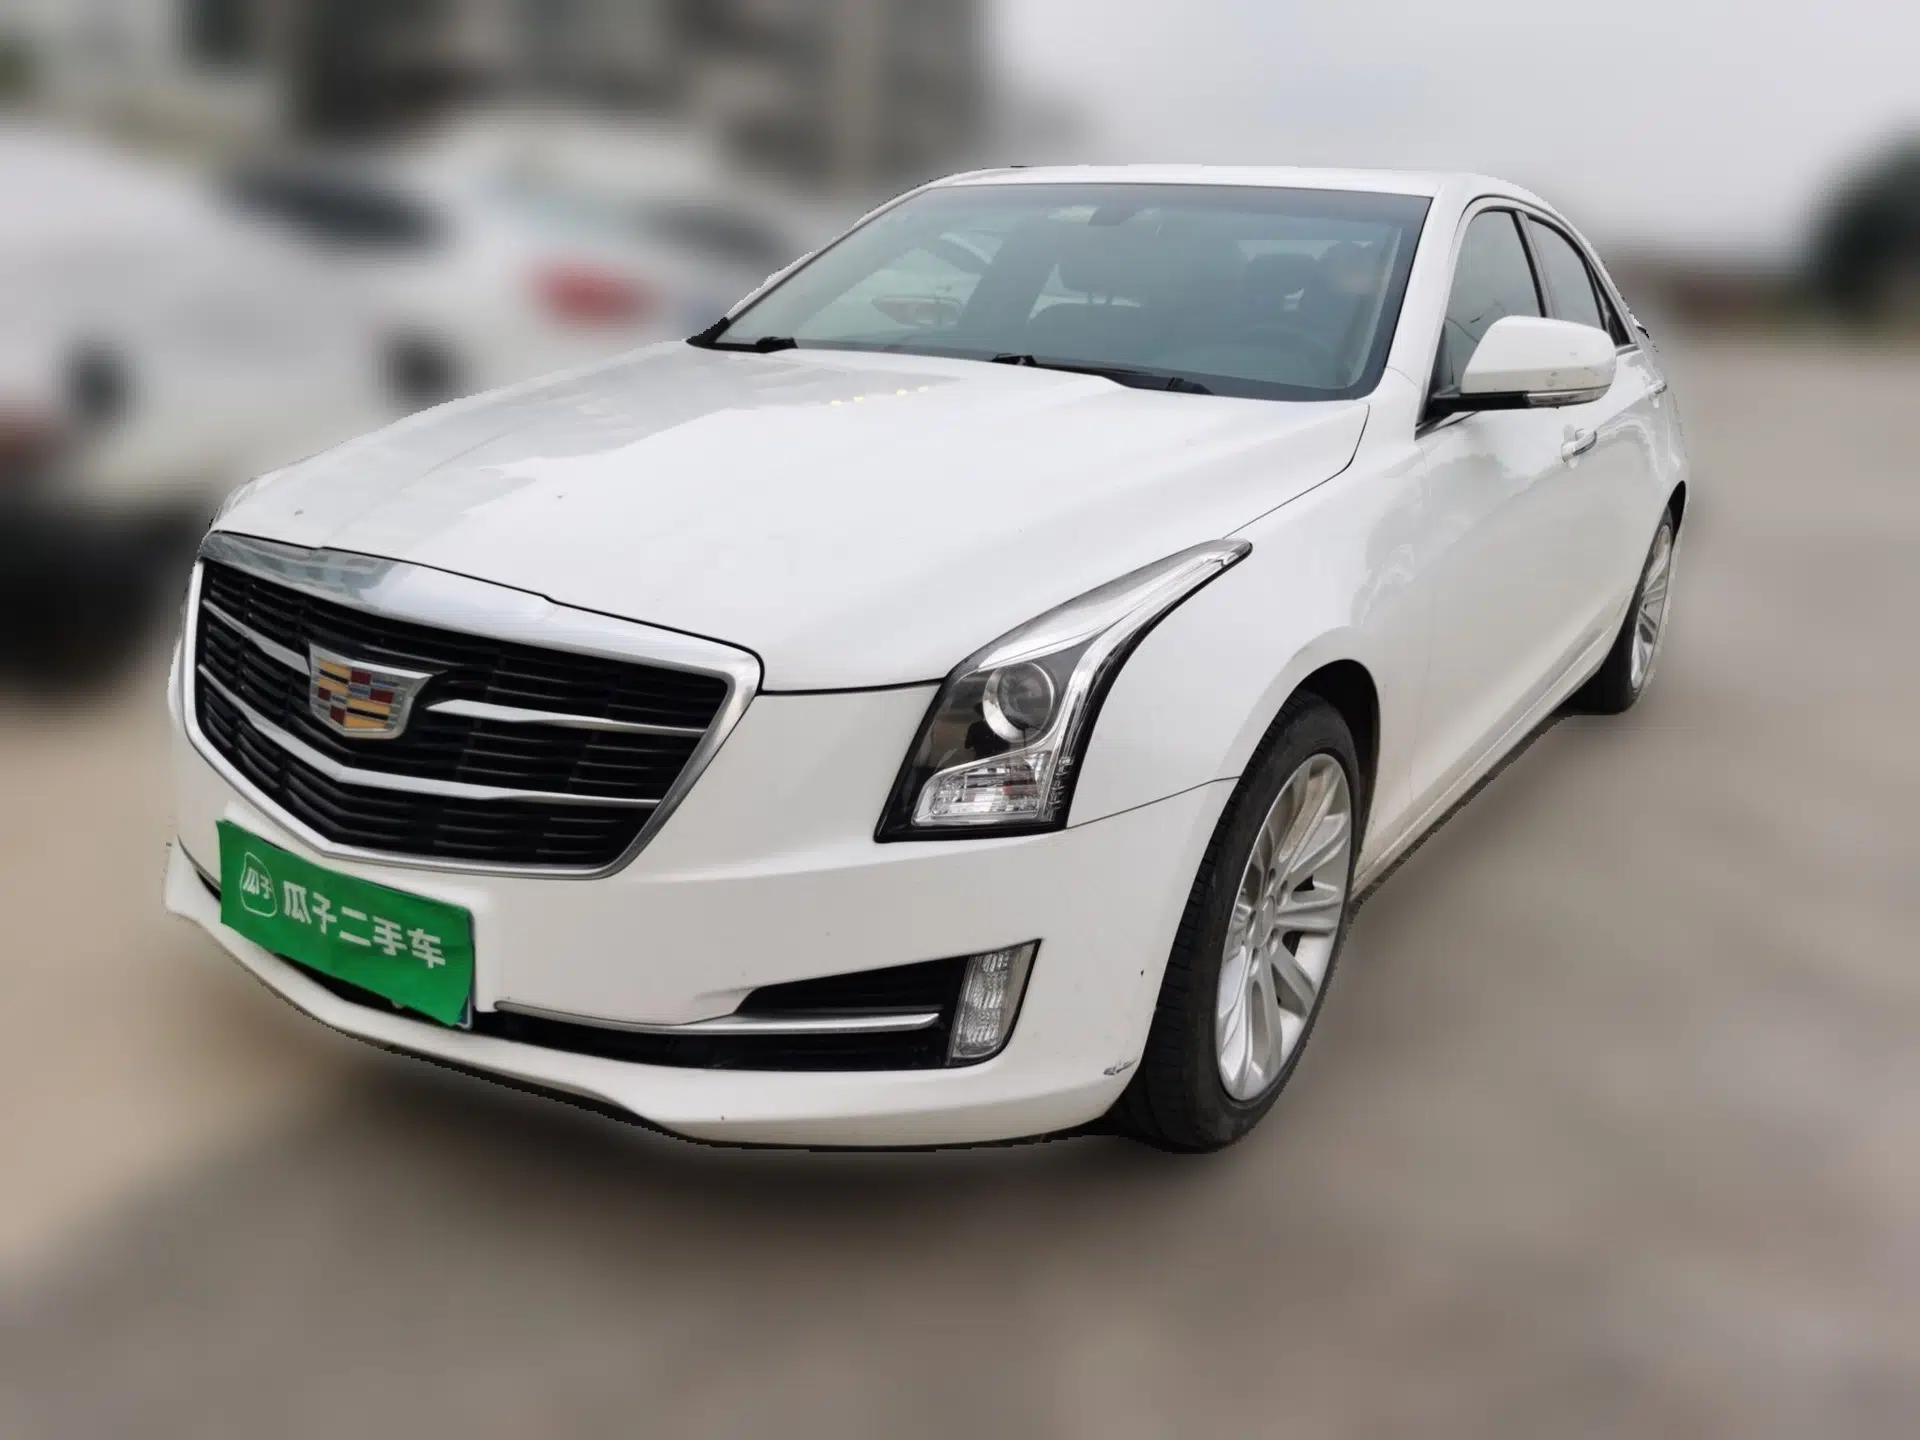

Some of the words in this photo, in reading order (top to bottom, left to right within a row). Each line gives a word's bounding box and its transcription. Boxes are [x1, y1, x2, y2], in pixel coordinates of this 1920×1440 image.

[242, 867, 272, 900] 瓜子
[283, 880, 446, 969] 瓜子二手车
